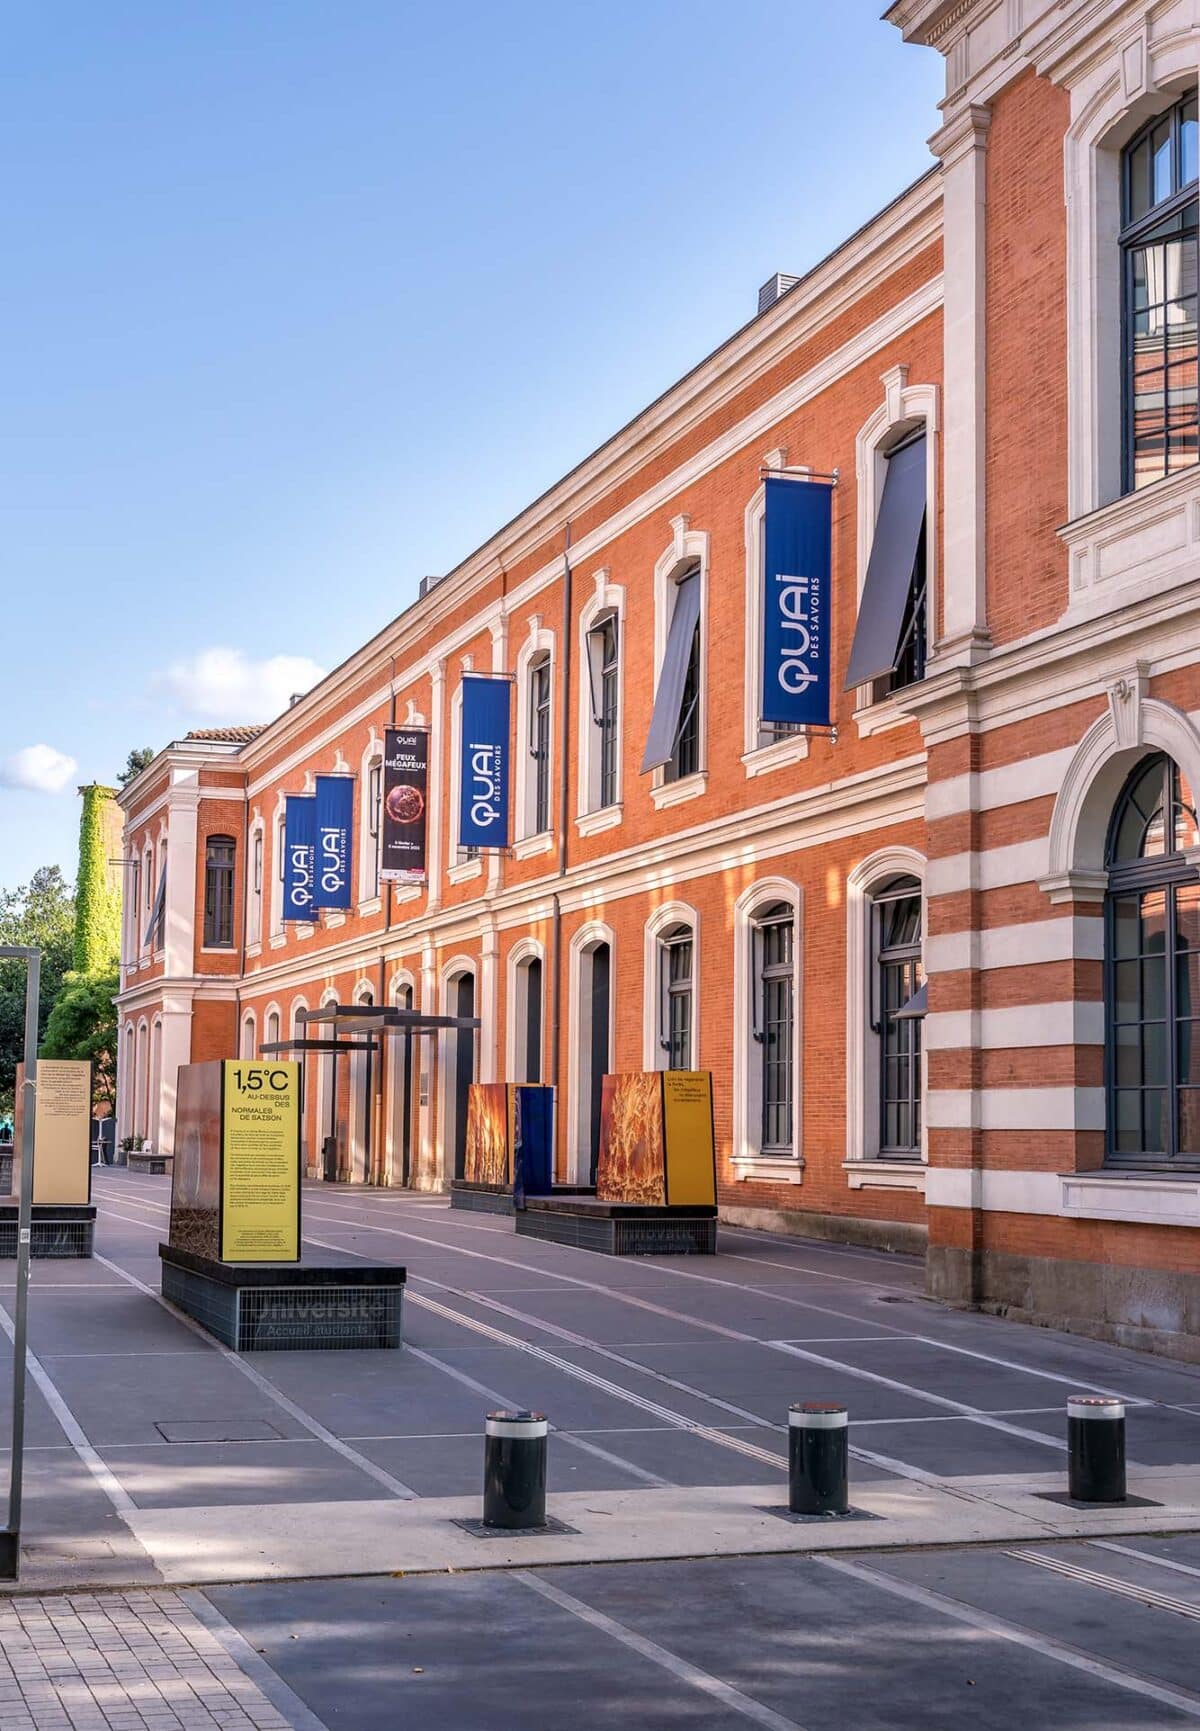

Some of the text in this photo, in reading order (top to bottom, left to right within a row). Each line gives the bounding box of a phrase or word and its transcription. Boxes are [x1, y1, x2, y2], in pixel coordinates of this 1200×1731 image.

[810, 577, 820, 659] DES SAVOIRS
[385, 759, 427, 770] MÉGAFEUX
[396, 753, 417, 762] FEUX
[494, 745, 502, 802] DES SAVOIRS
[233, 1069, 289, 1094] 1,5°C
[247, 1093, 290, 1101] AU-DESSUS
